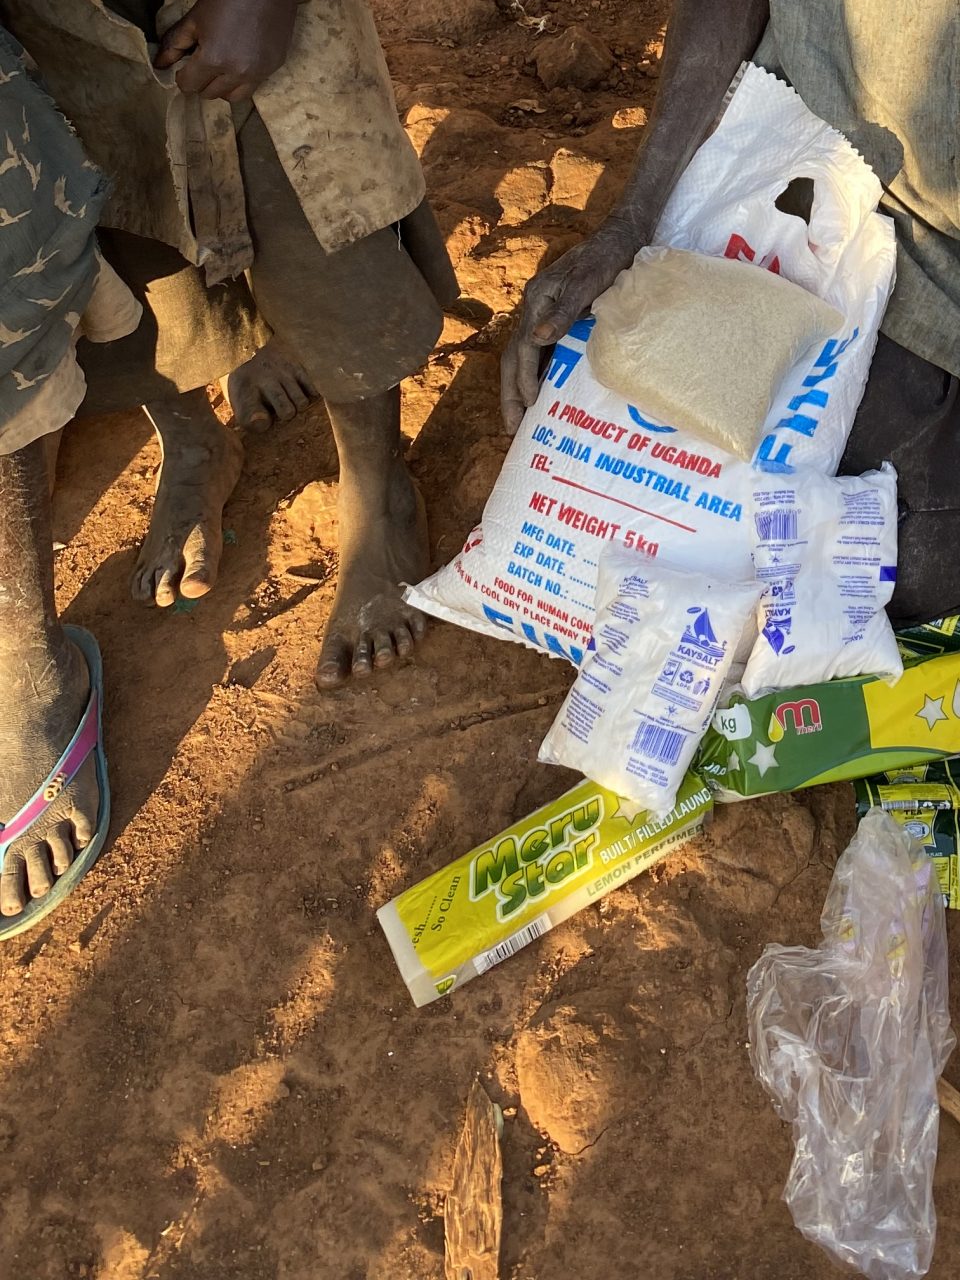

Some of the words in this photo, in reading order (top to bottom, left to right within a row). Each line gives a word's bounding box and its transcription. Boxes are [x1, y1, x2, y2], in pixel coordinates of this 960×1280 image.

[547, 400, 561, 418] A
[559, 406, 628, 443] PRODUCT
[627, 433, 652, 452] OF
[651, 440, 723, 480] UGANDA
[530, 453, 554, 474] TEL:
[531, 424, 557, 447] LOC:
[555, 435, 592, 464] JINJA
[594, 452, 690, 503] INDUSTRIAL
[694, 492, 743, 522] AREA
[521, 521, 544, 542] MFG
[529, 491, 558, 517] NET
[557, 503, 621, 542] WEIGHT
[513, 541, 534, 559] EXP
[507, 561, 542, 586] BATCH
[480, 584, 501, 603] COOL
[503, 598, 520, 615] DRY
[552, 622, 579, 641] AWAY
[493, 576, 515, 596] FOOD
[516, 587, 534, 605] FOR
[537, 599, 569, 623] HUMAN
[677, 644, 720, 666] KAYSALT
[721, 715, 737, 733] kg
[636, 811, 674, 842] FILLED
[471, 796, 602, 900] Meru
[499, 832, 597, 920] Star
[586, 861, 632, 897] LEMON
[431, 916, 445, 931] So
[440, 875, 461, 912] Clean
